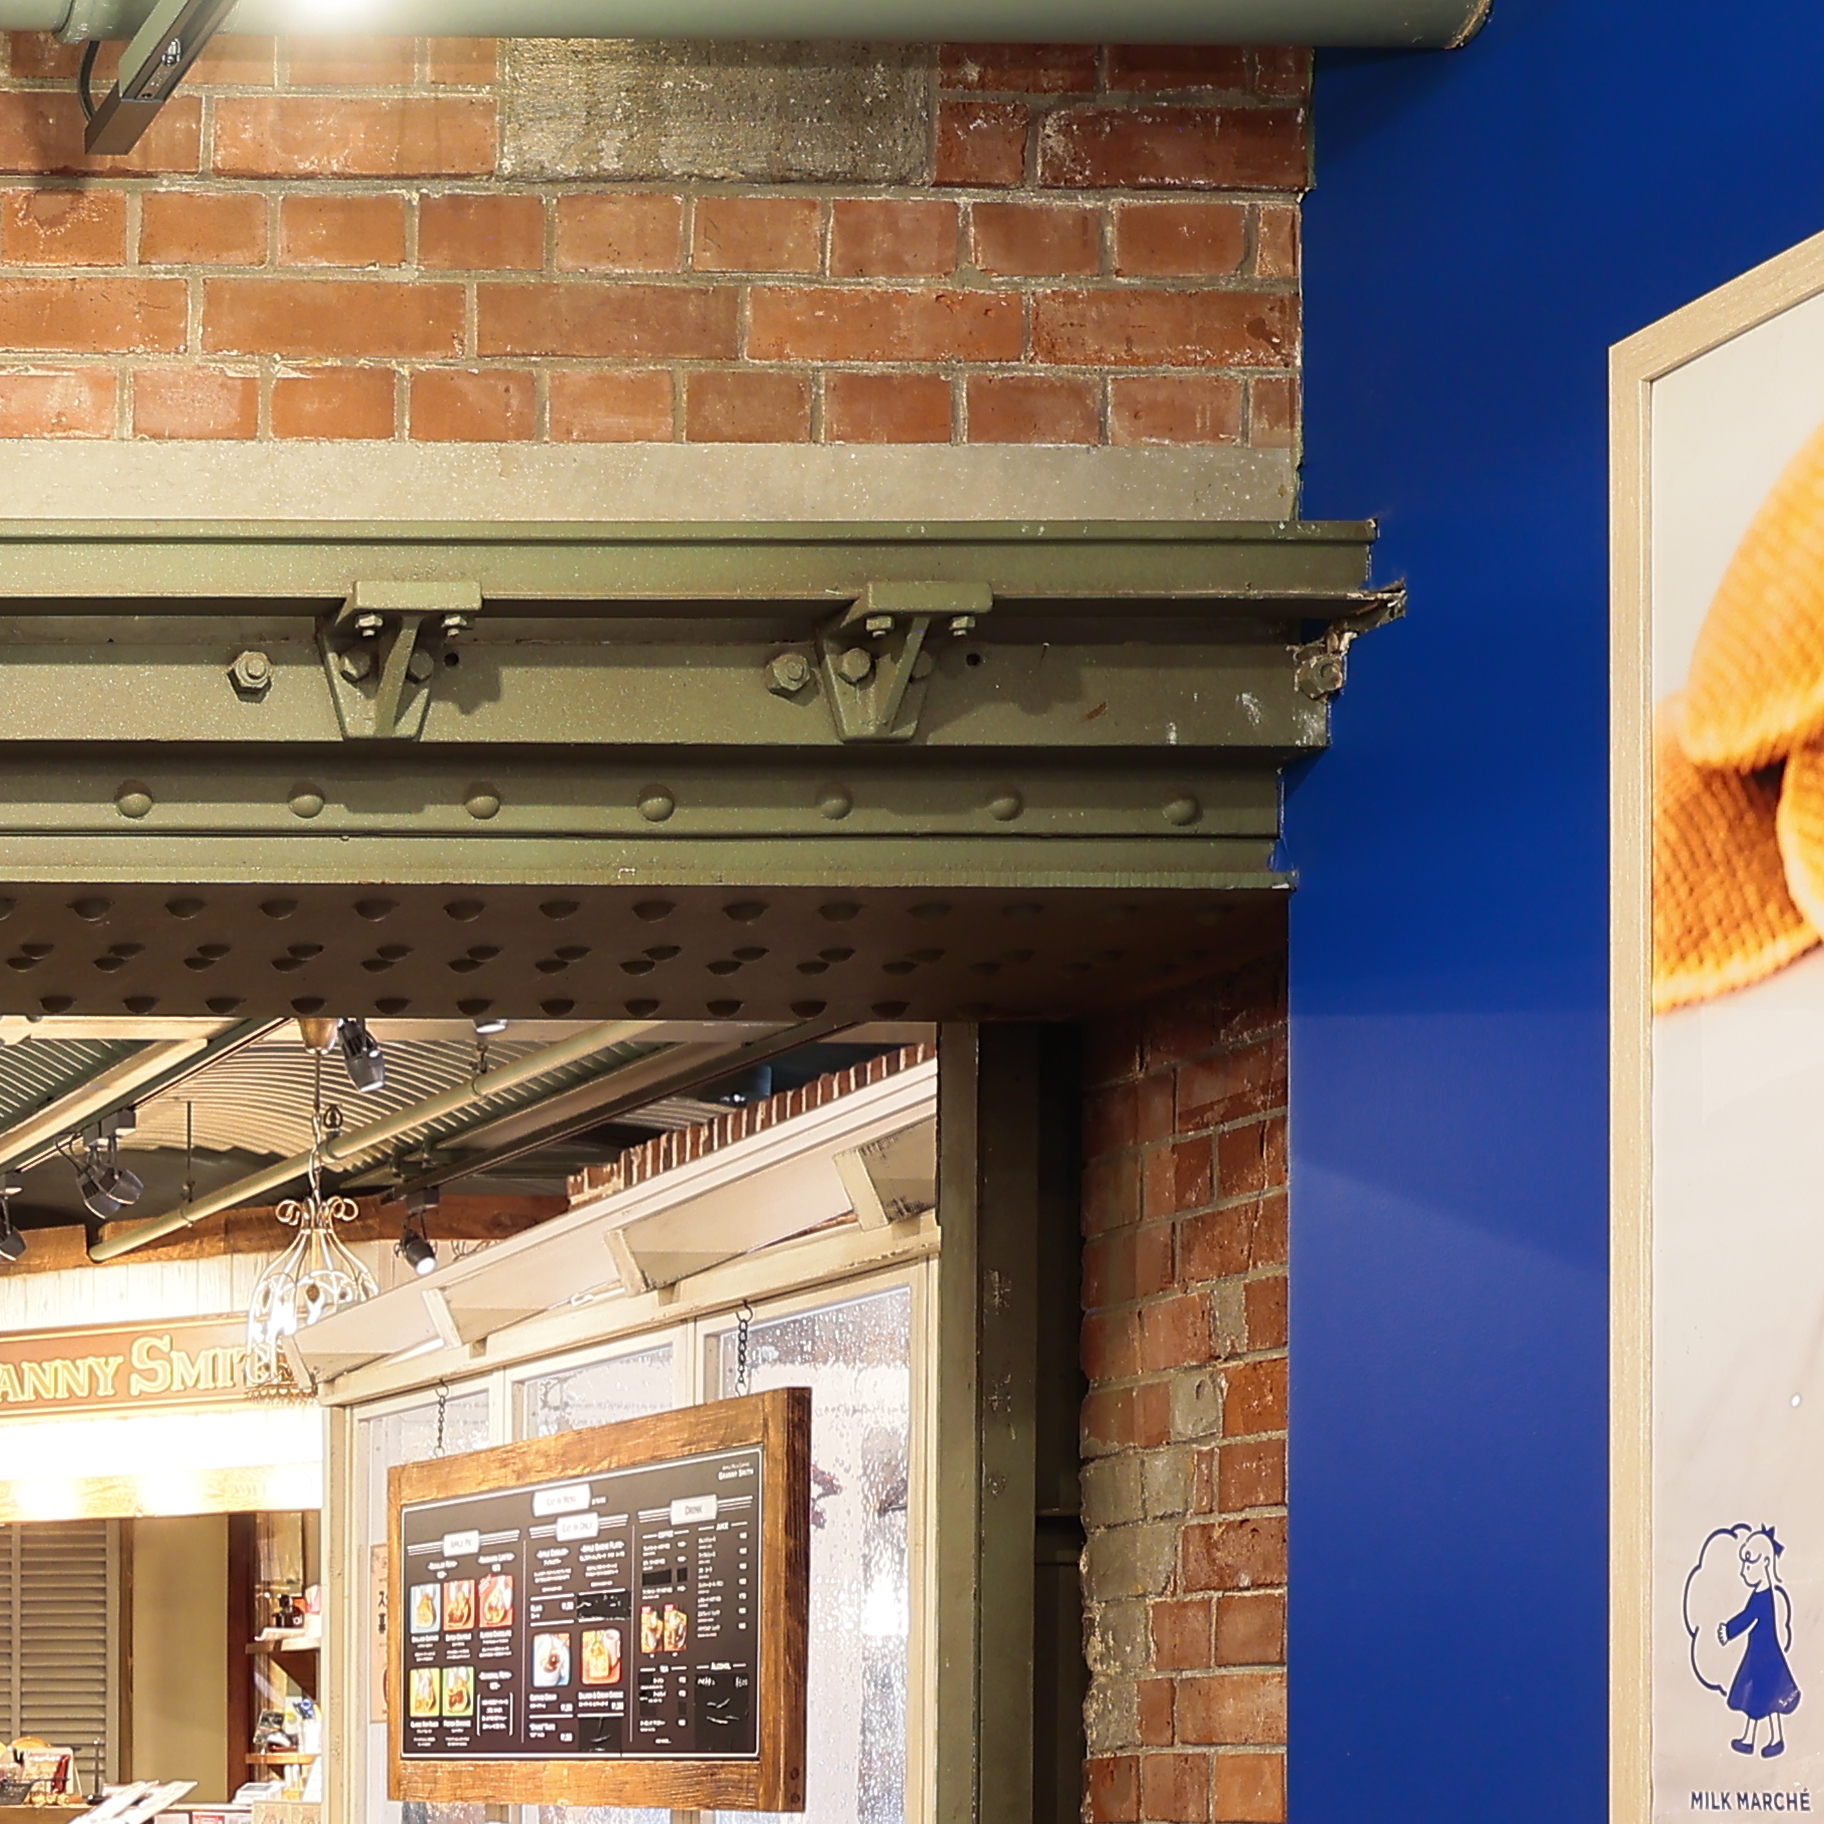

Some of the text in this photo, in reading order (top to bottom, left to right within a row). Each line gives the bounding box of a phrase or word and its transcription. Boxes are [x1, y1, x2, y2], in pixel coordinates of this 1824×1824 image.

[130, 1335, 264, 1397] SMIT
[1691, 1787, 1811, 1812] MILK MARCHÉ
